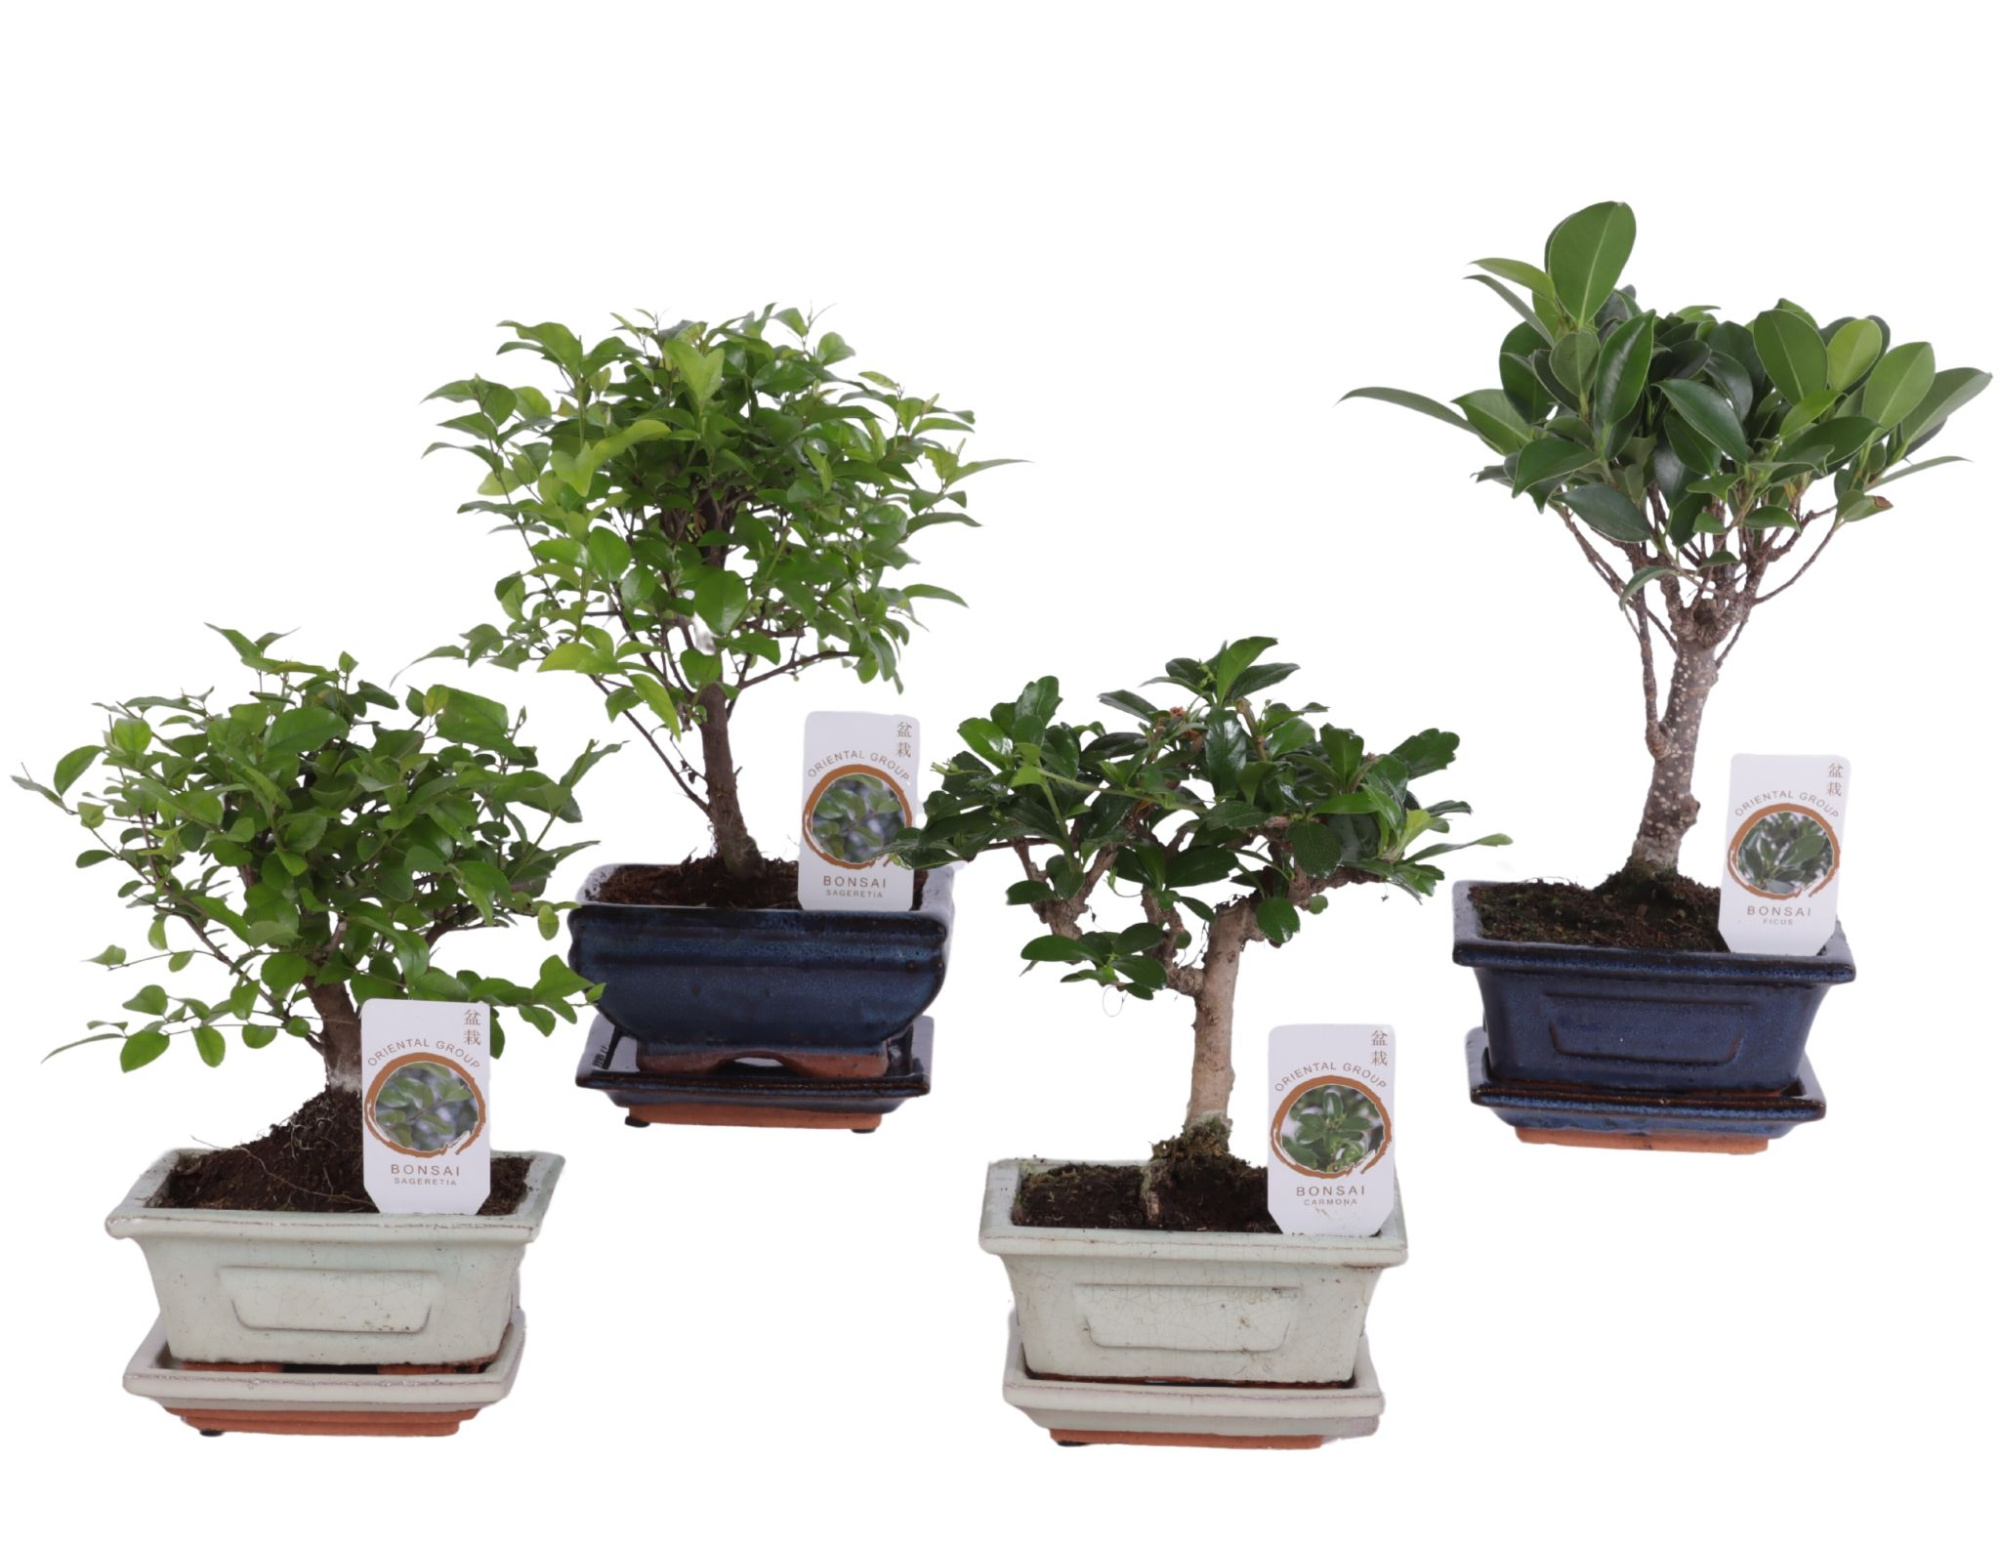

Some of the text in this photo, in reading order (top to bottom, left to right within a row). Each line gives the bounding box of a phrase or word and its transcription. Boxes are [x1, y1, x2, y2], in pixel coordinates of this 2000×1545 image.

[808, 750, 909, 780] ORIENTAL GROUP
[1735, 790, 1839, 818] ORIENTAL GROUP
[823, 876, 886, 888] BONSAI
[826, 889, 883, 898] SAGERETIA
[1747, 906, 1811, 917] BONSAI
[368, 1038, 480, 1069] ORIENTAL GROUP
[1274, 1062, 1387, 1092] ORIENTAL GROUP
[390, 1164, 460, 1176] BONSAI
[394, 1177, 457, 1186] SAGERETIA
[1296, 1185, 1365, 1197] BONSAI
[1303, 1198, 1357, 1206] CARMONA
